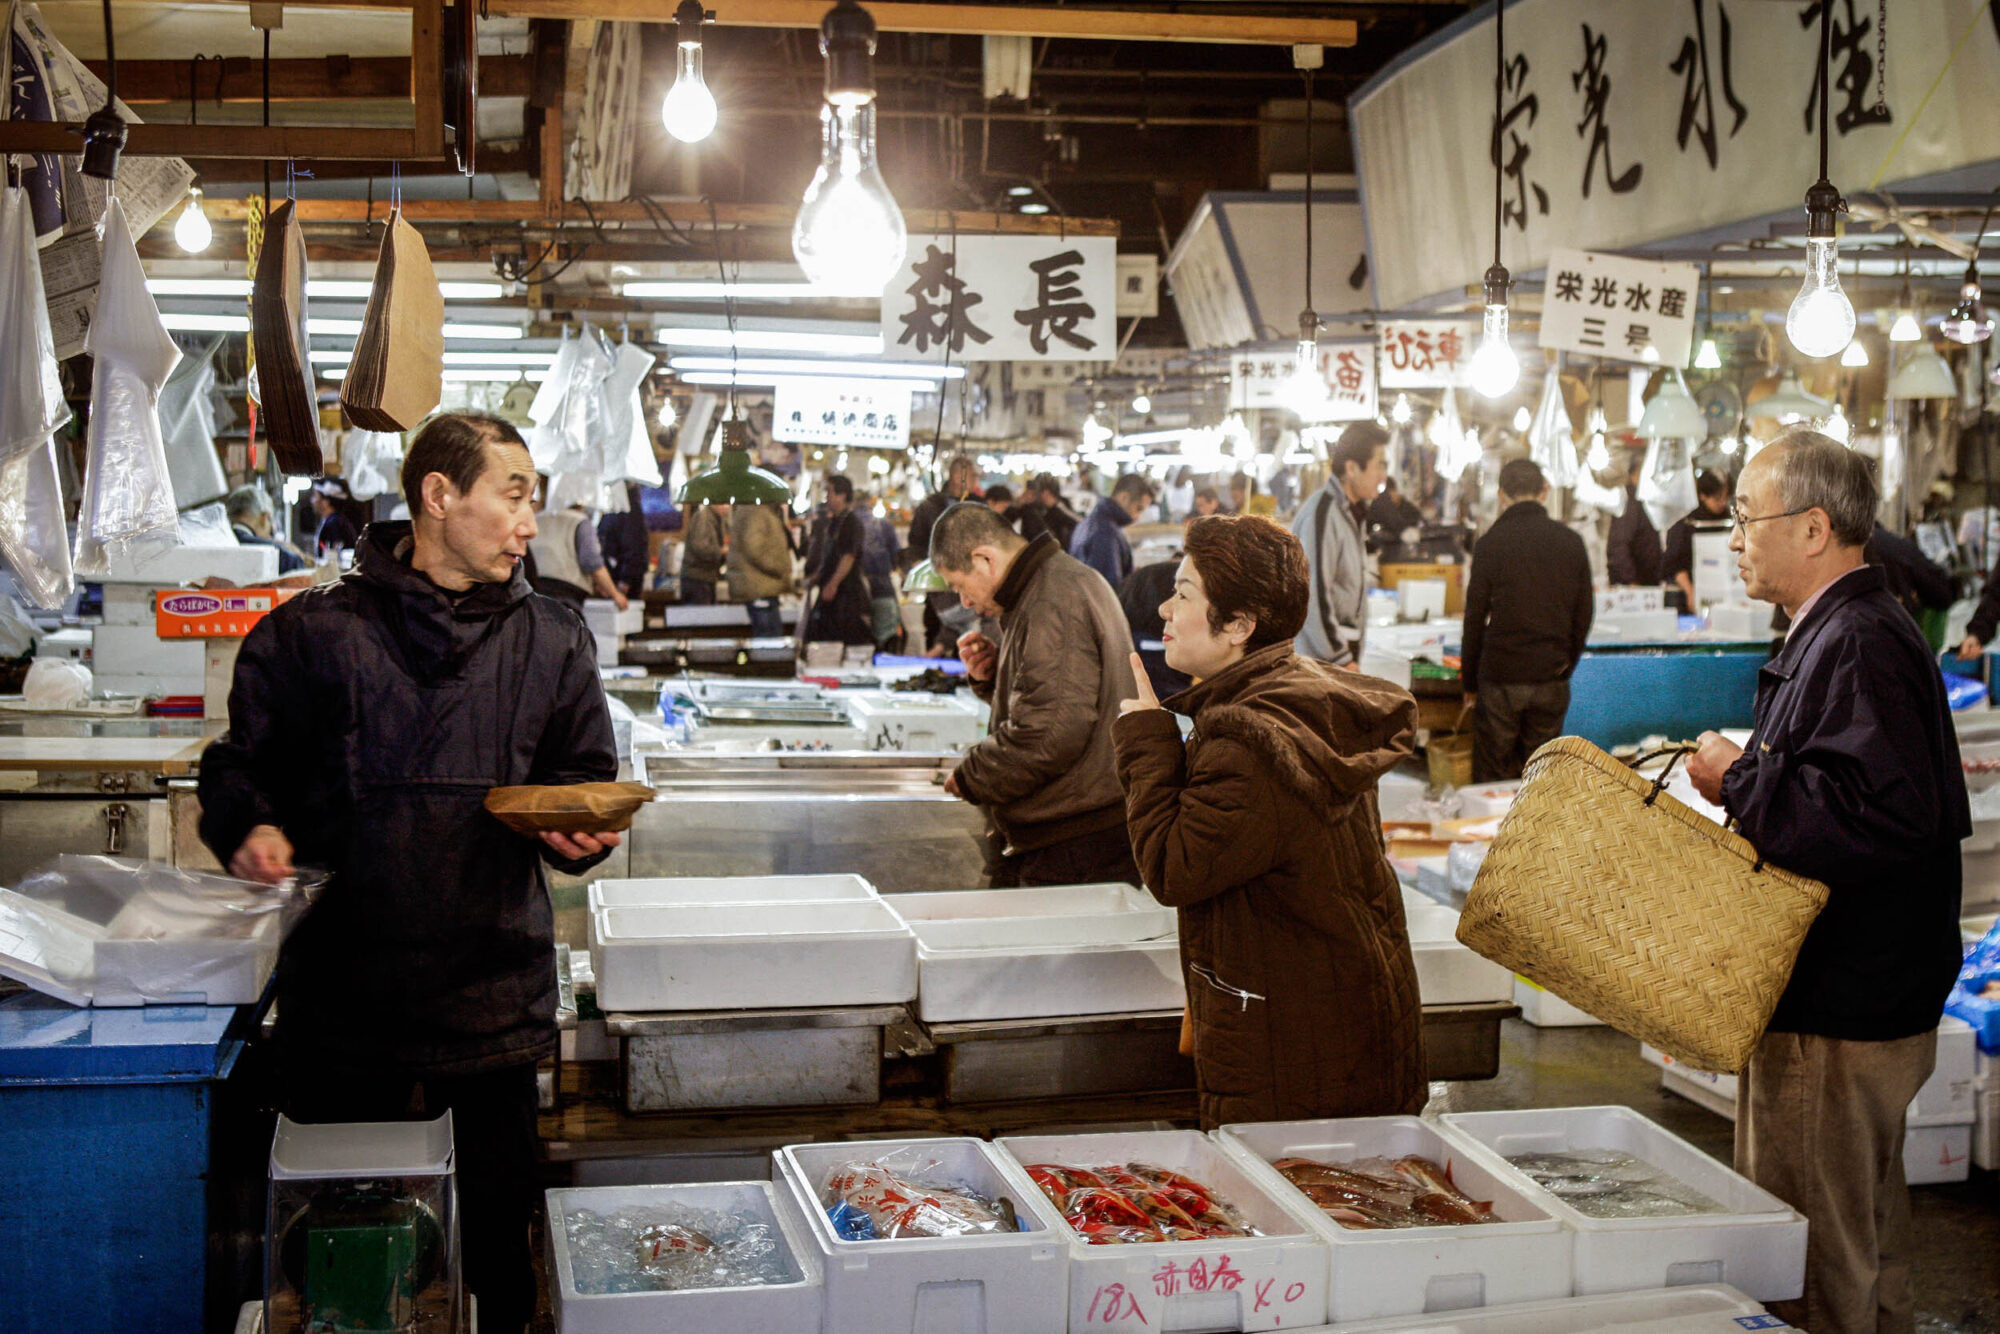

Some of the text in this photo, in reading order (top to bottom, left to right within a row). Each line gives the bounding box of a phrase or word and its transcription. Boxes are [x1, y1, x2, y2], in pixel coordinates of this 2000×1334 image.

[897, 244, 1098, 355] 森長
[1555, 270, 1687, 318] 栄光水産
[1579, 317, 1650, 353] 三号
[169, 600, 216, 611] たらばがに
